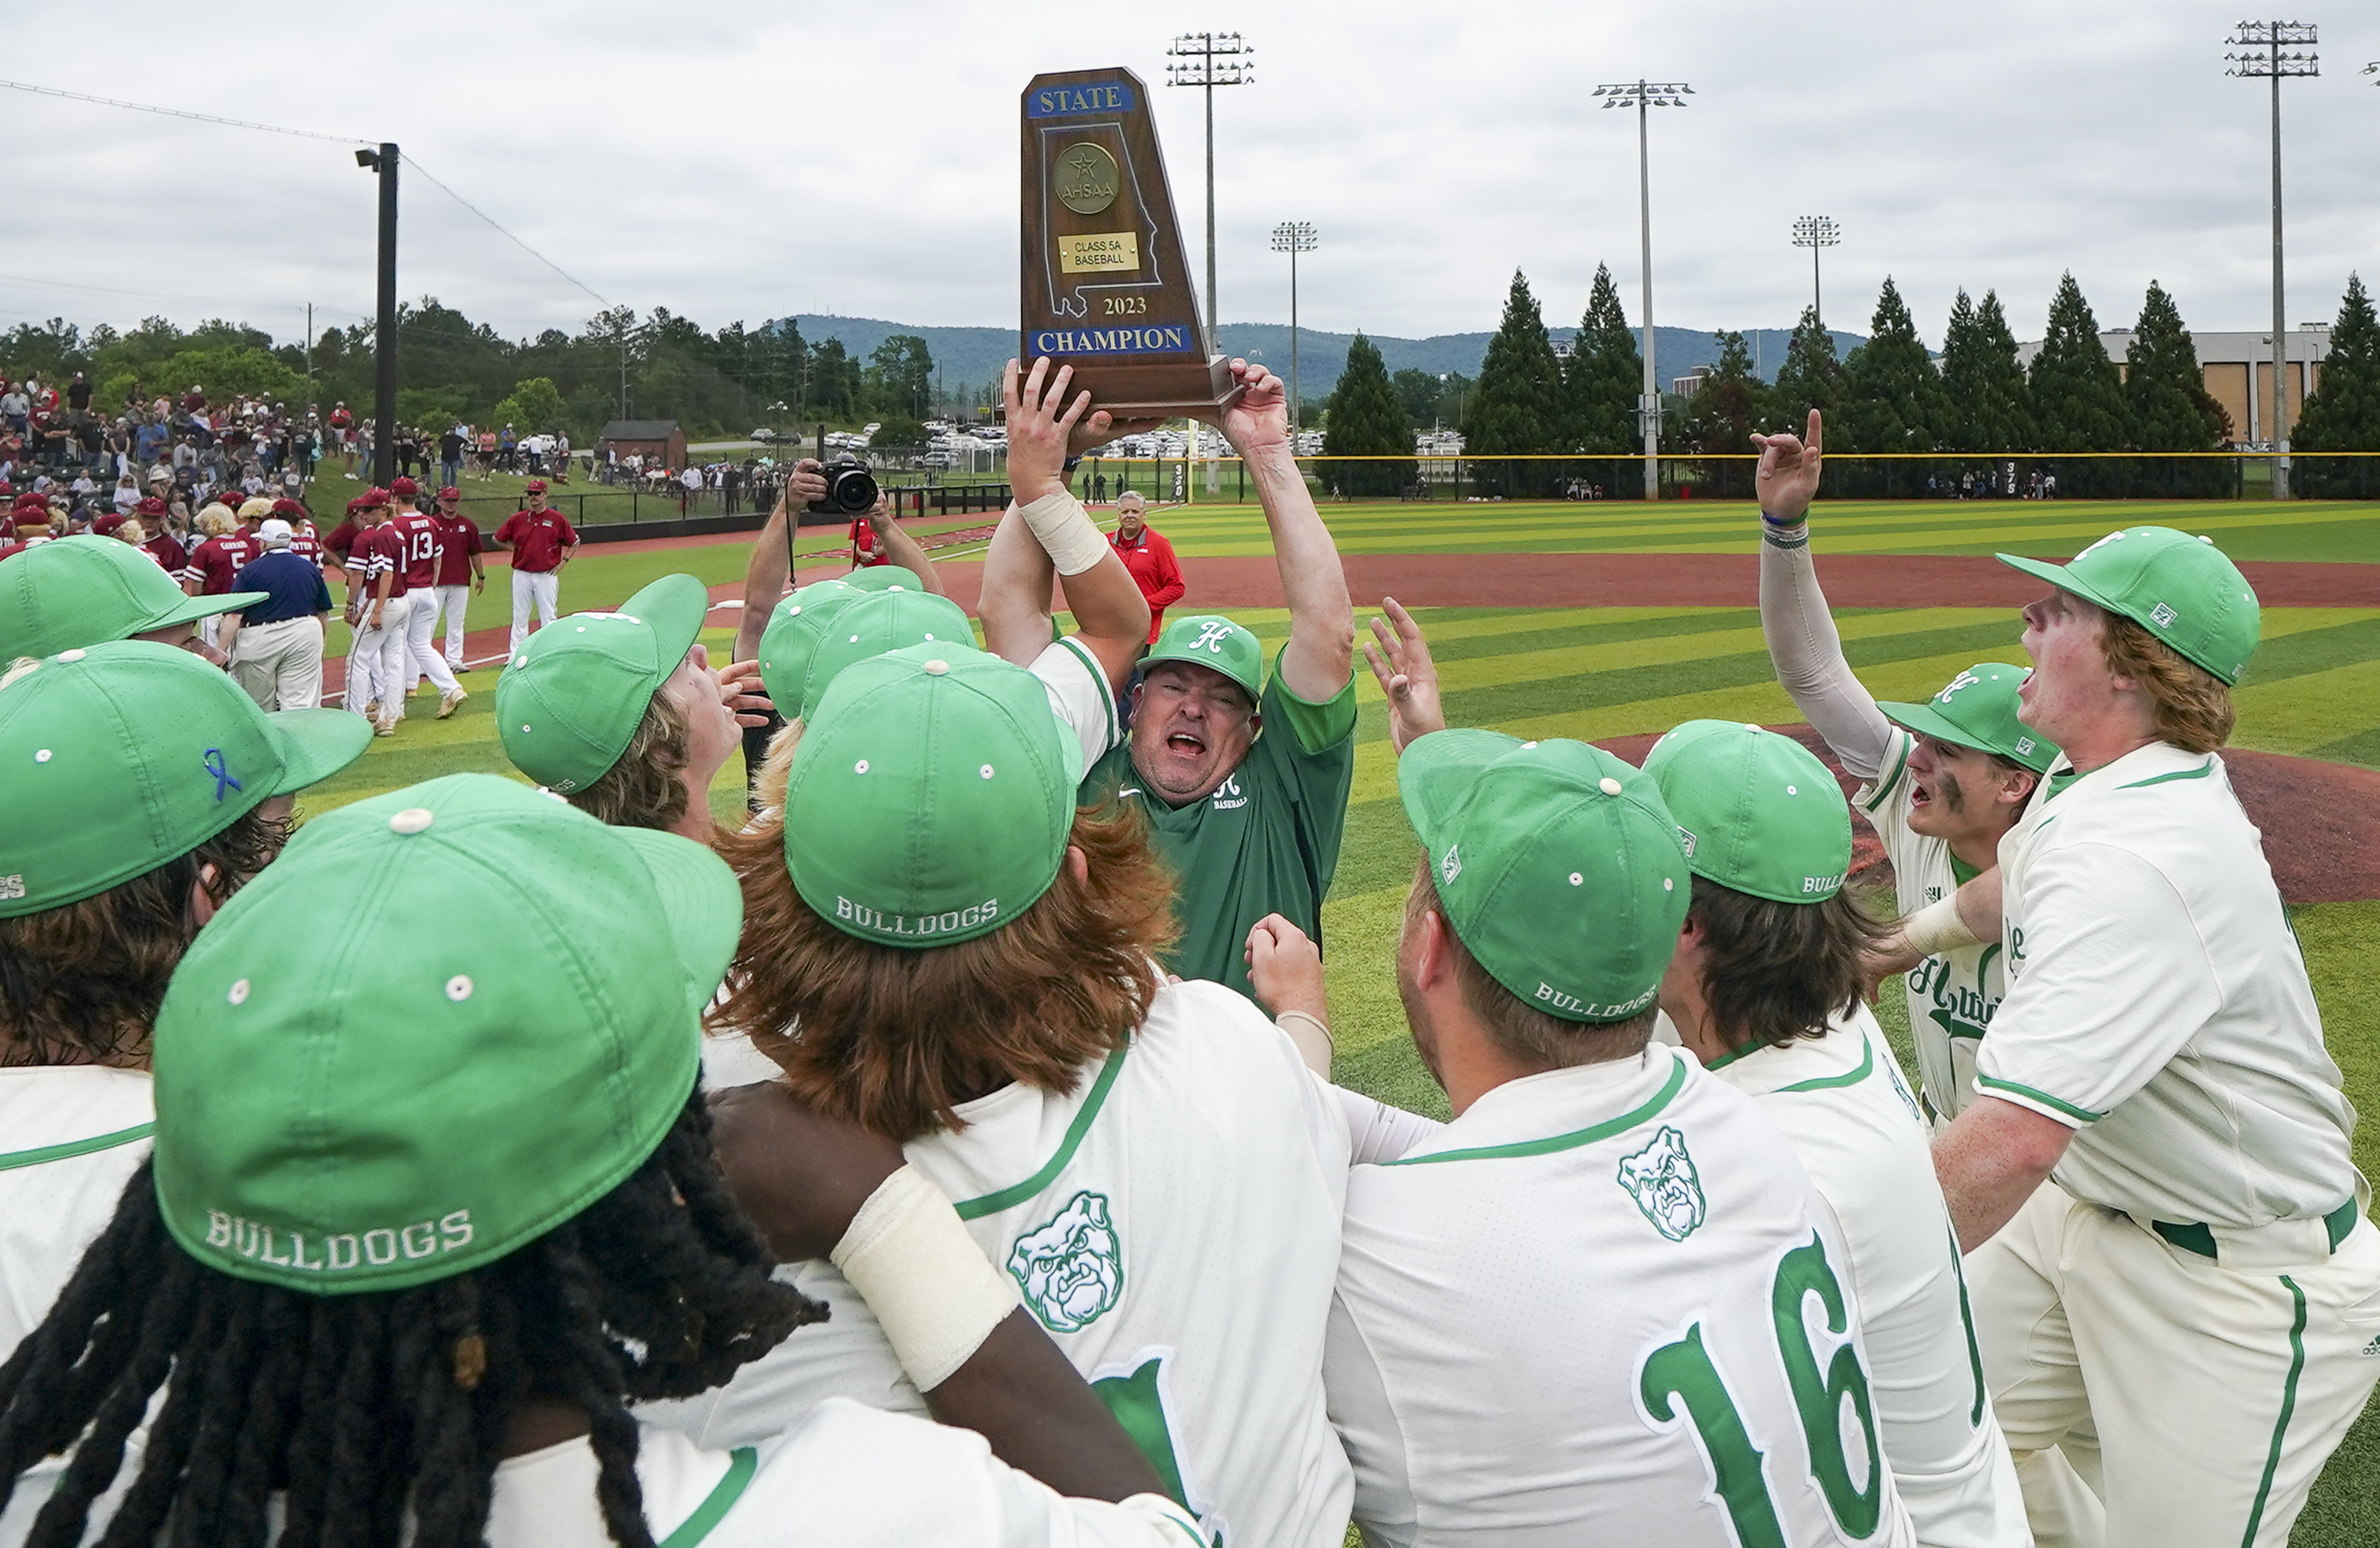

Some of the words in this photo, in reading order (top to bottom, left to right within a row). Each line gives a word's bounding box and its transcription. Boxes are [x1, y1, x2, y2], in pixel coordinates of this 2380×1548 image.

[1040, 86, 1122, 113] STATE
[1060, 183, 1114, 200] AHSAA
[1074, 242, 1106, 253] CLASS
[1108, 242, 1121, 252] 5A
[1075, 253, 1124, 266] BASEBALL
[1103, 296, 1147, 316] 2023
[1037, 327, 1183, 354] CHAMPION
[411, 531, 434, 561] 13
[1188, 621, 1233, 654] H
[836, 894, 998, 935] BULLDOGS
[1534, 981, 1657, 1018] BULLDOGS
[205, 1208, 474, 1271] BULLDOGS
[1632, 1222, 1887, 1548] 16
